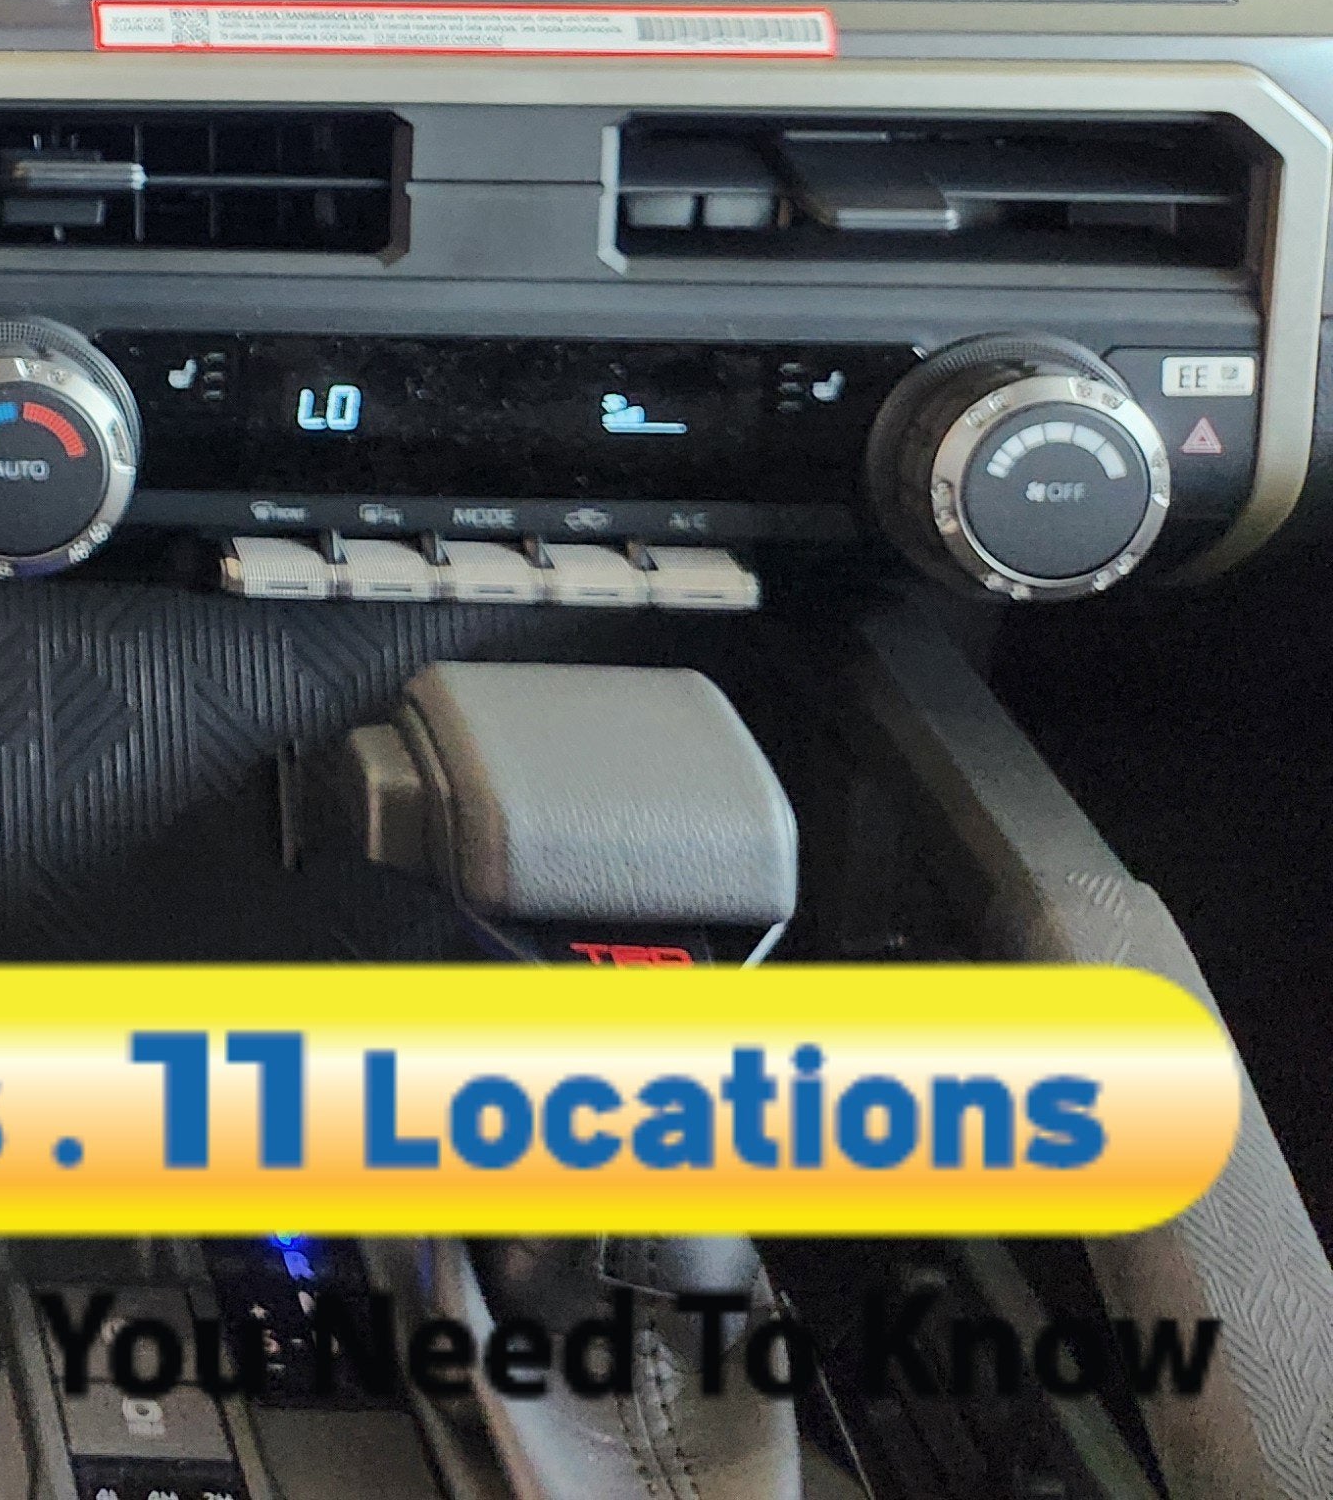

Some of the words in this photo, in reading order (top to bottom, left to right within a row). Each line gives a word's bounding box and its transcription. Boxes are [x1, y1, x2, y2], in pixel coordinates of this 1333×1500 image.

[297, 385, 362, 430] LO
[1046, 481, 1087, 502] OFF
[452, 508, 516, 528] MODE
